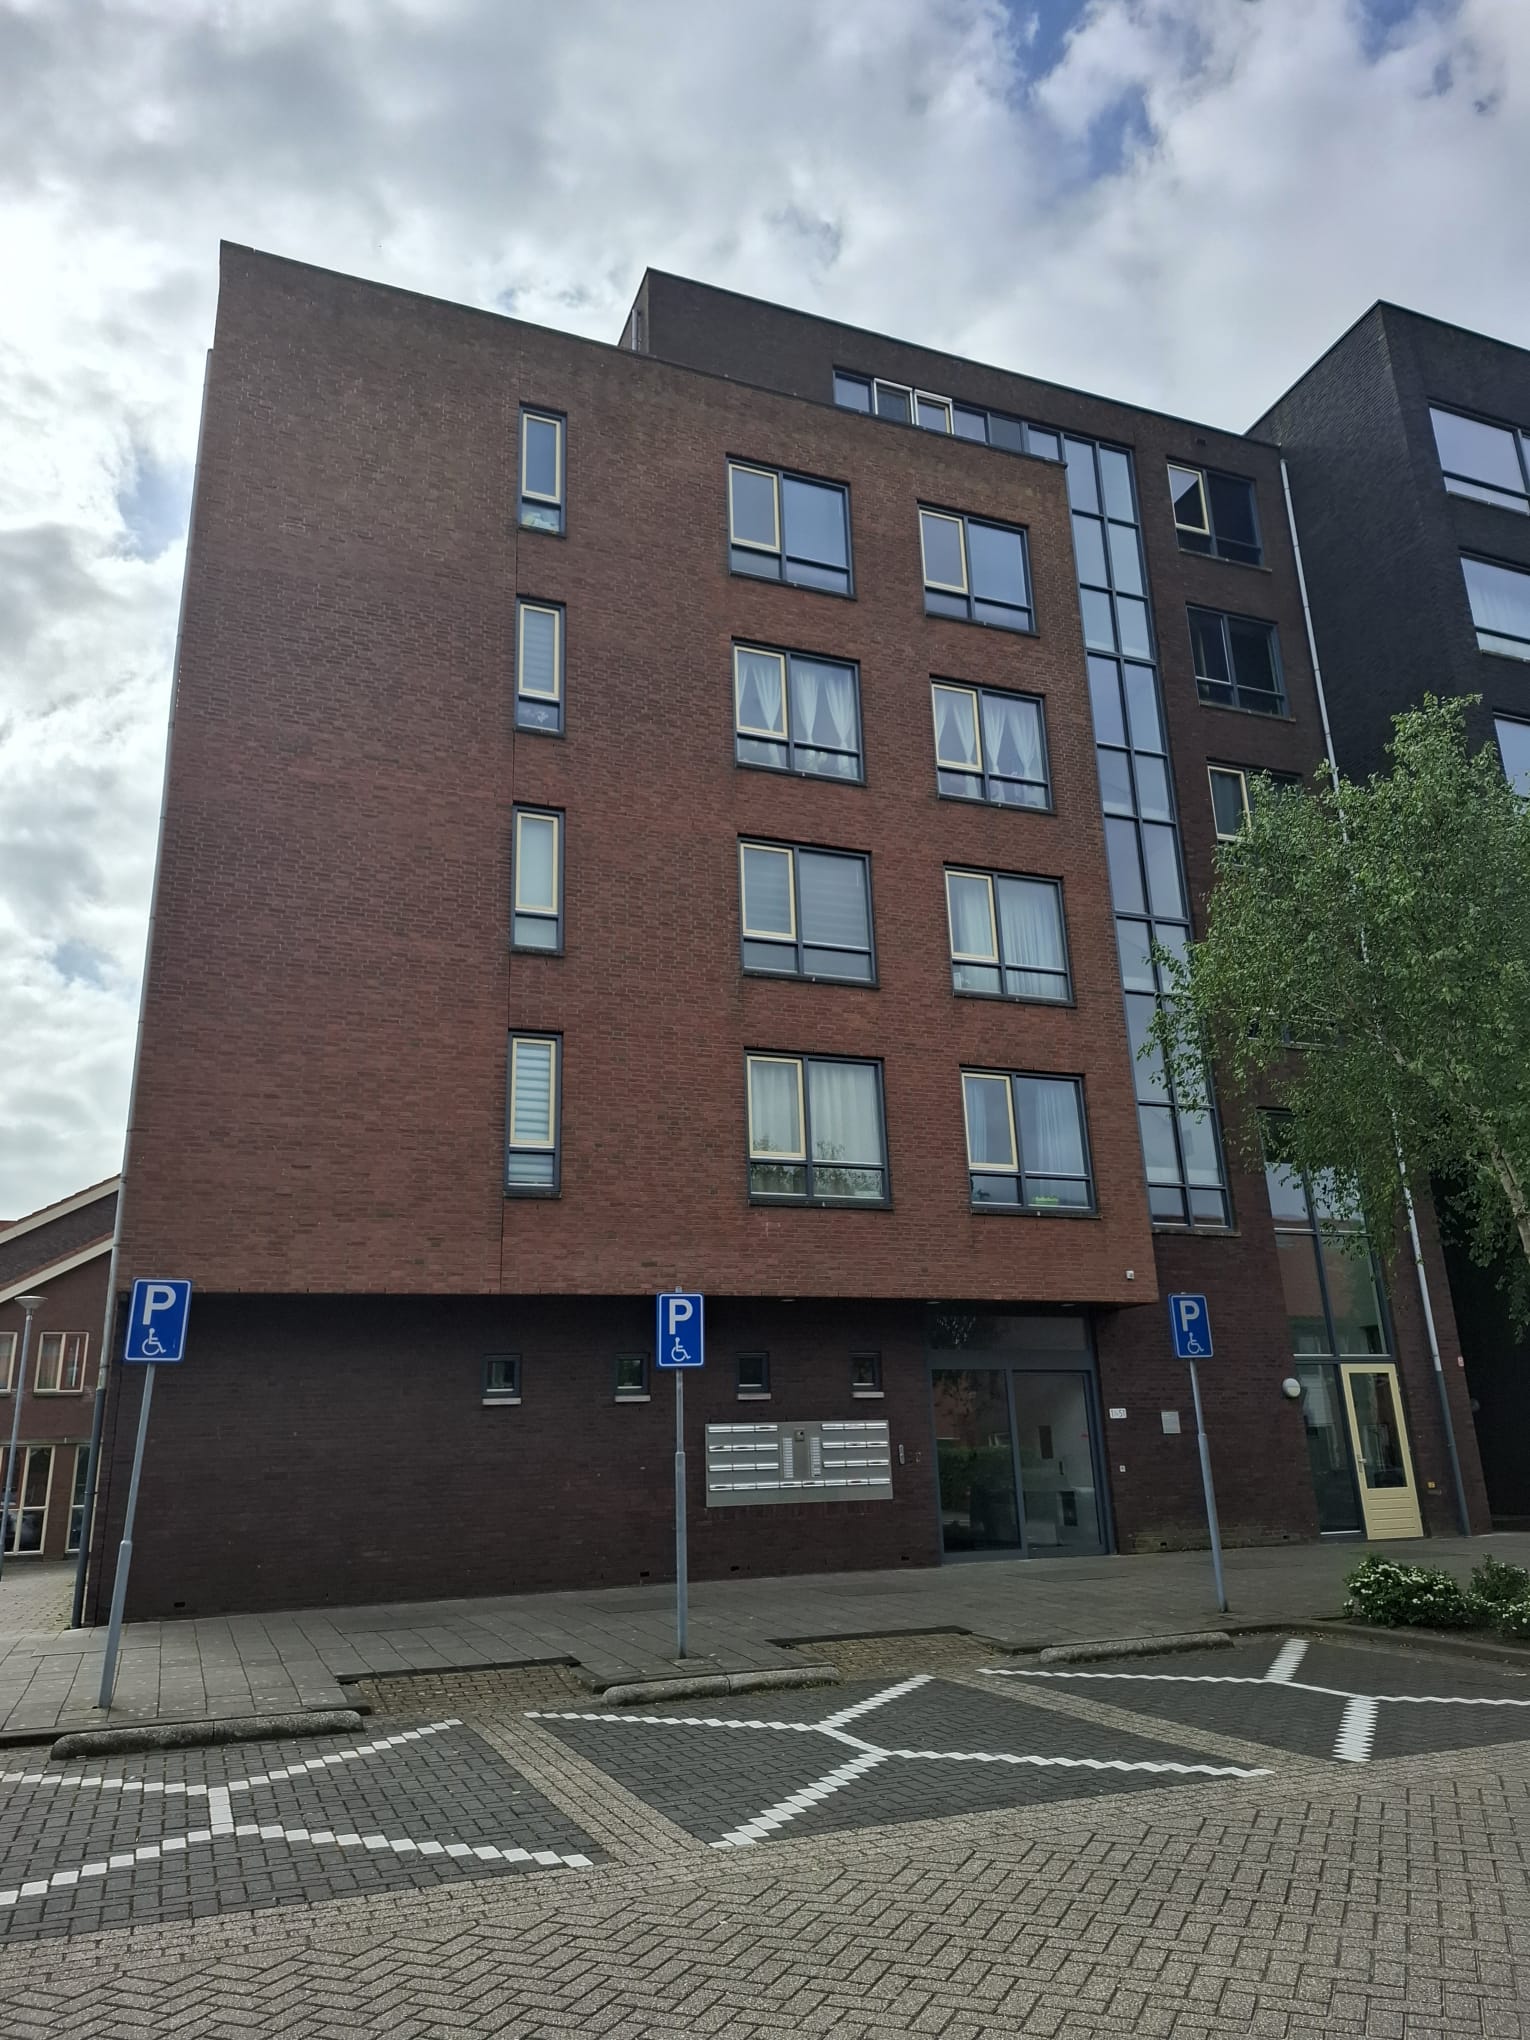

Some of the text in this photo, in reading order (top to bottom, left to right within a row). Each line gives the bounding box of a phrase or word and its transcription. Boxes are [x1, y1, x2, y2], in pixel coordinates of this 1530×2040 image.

[142, 1284, 176, 1326] P
[669, 1298, 693, 1335] P
[1180, 1300, 1200, 1332] P
